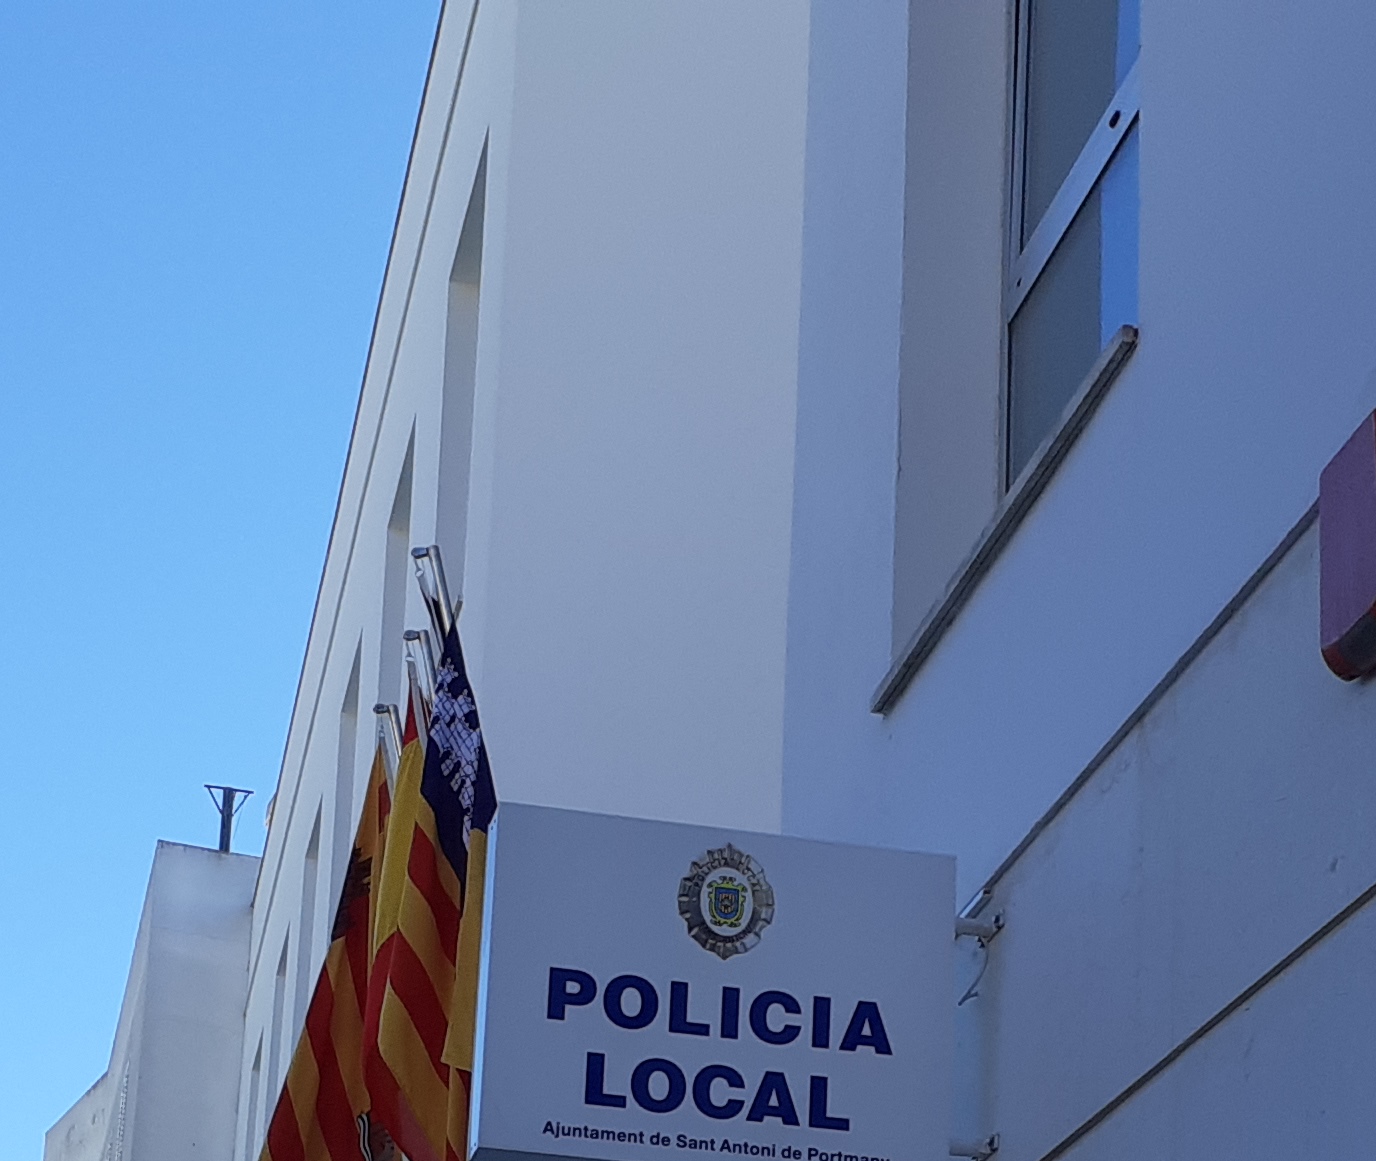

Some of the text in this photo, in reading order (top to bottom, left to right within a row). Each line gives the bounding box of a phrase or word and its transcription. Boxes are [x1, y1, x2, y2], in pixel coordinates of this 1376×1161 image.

[546, 966, 893, 1056] POLICIA
[583, 1051, 851, 1132] LOCAL
[542, 1120, 645, 1145] Ajuntament
[649, 1132, 671, 1147] de
[676, 1134, 716, 1152] Sant
[720, 1139, 776, 1158] Antoni
[781, 1146, 802, 1160] de
